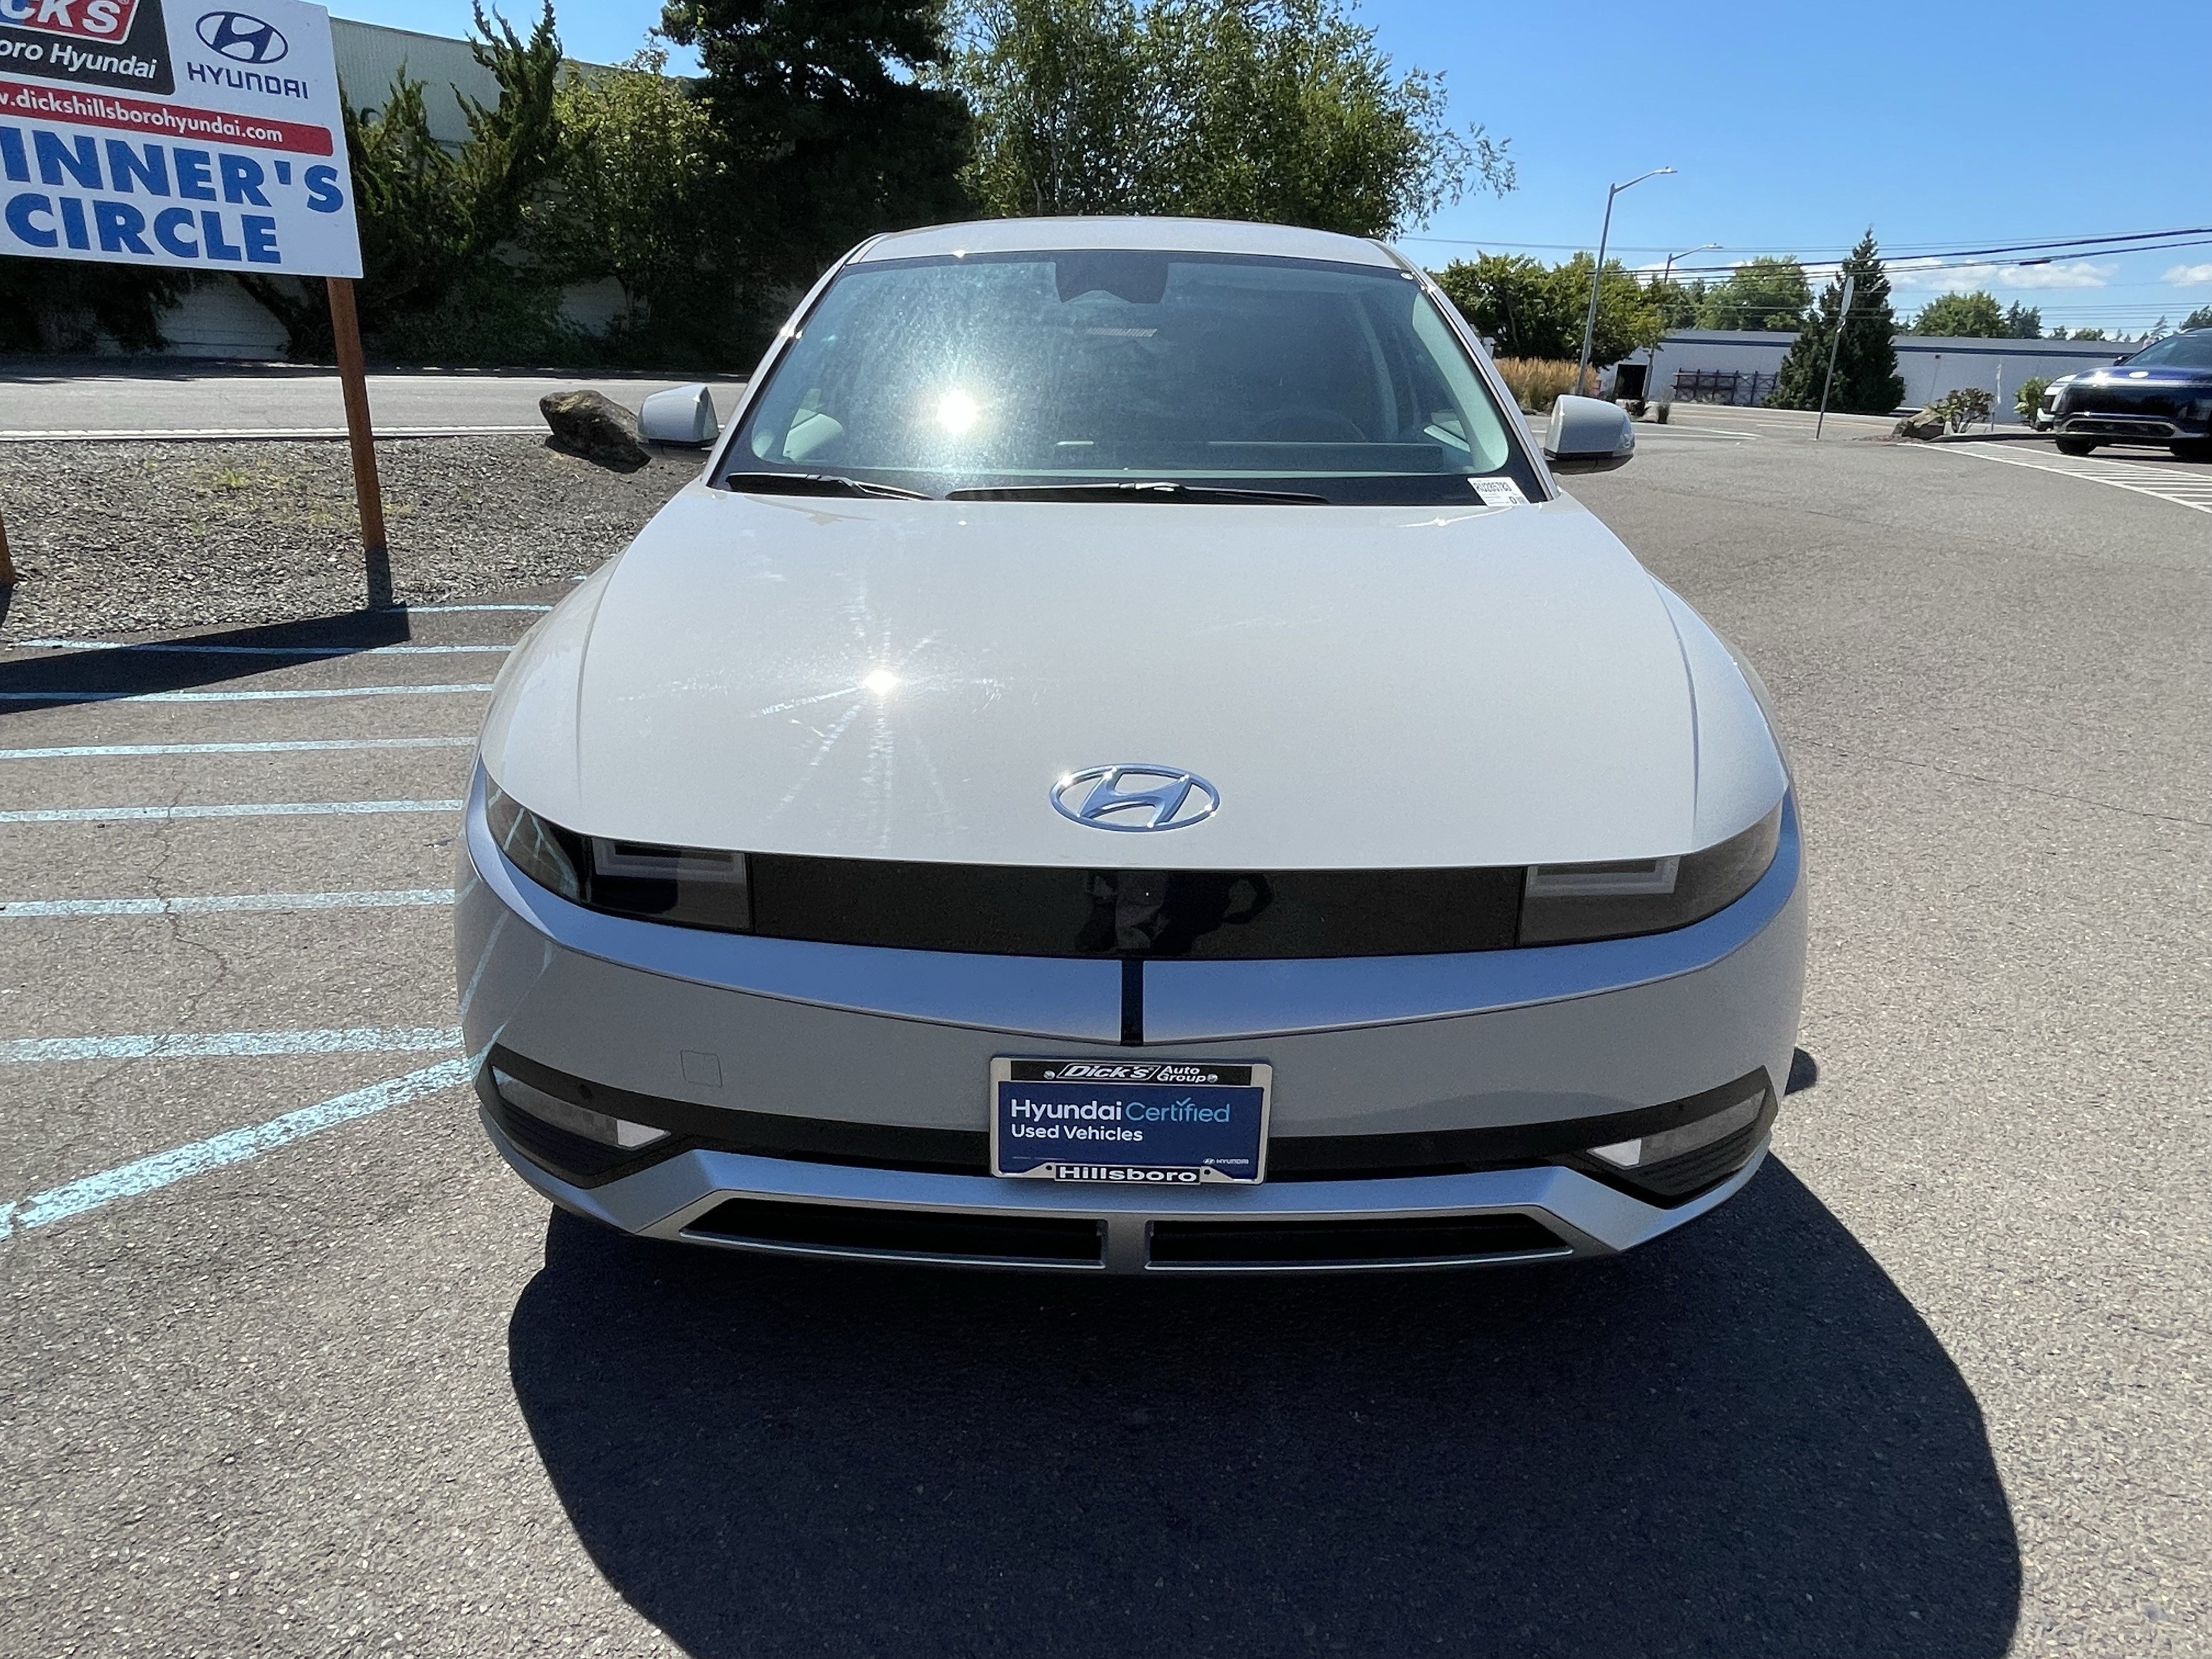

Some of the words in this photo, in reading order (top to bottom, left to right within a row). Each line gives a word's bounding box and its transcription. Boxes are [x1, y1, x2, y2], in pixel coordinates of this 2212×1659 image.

[49, 43, 158, 80] Hyundai
[187, 62, 309, 99] HYUNDAI
[5, 193, 281, 264] CIRCLE
[1064, 1065, 1150, 1079] Dick's
[1161, 1065, 1200, 1074] Auto
[1157, 1074, 1206, 1082] Group
[1011, 1099, 1122, 1122] Hyundai
[1125, 1097, 1231, 1122] Certified
[1012, 1124, 1059, 1139] Used
[1063, 1125, 1143, 1142] Vehicles
[1059, 1166, 1197, 1182] Hillsboro
